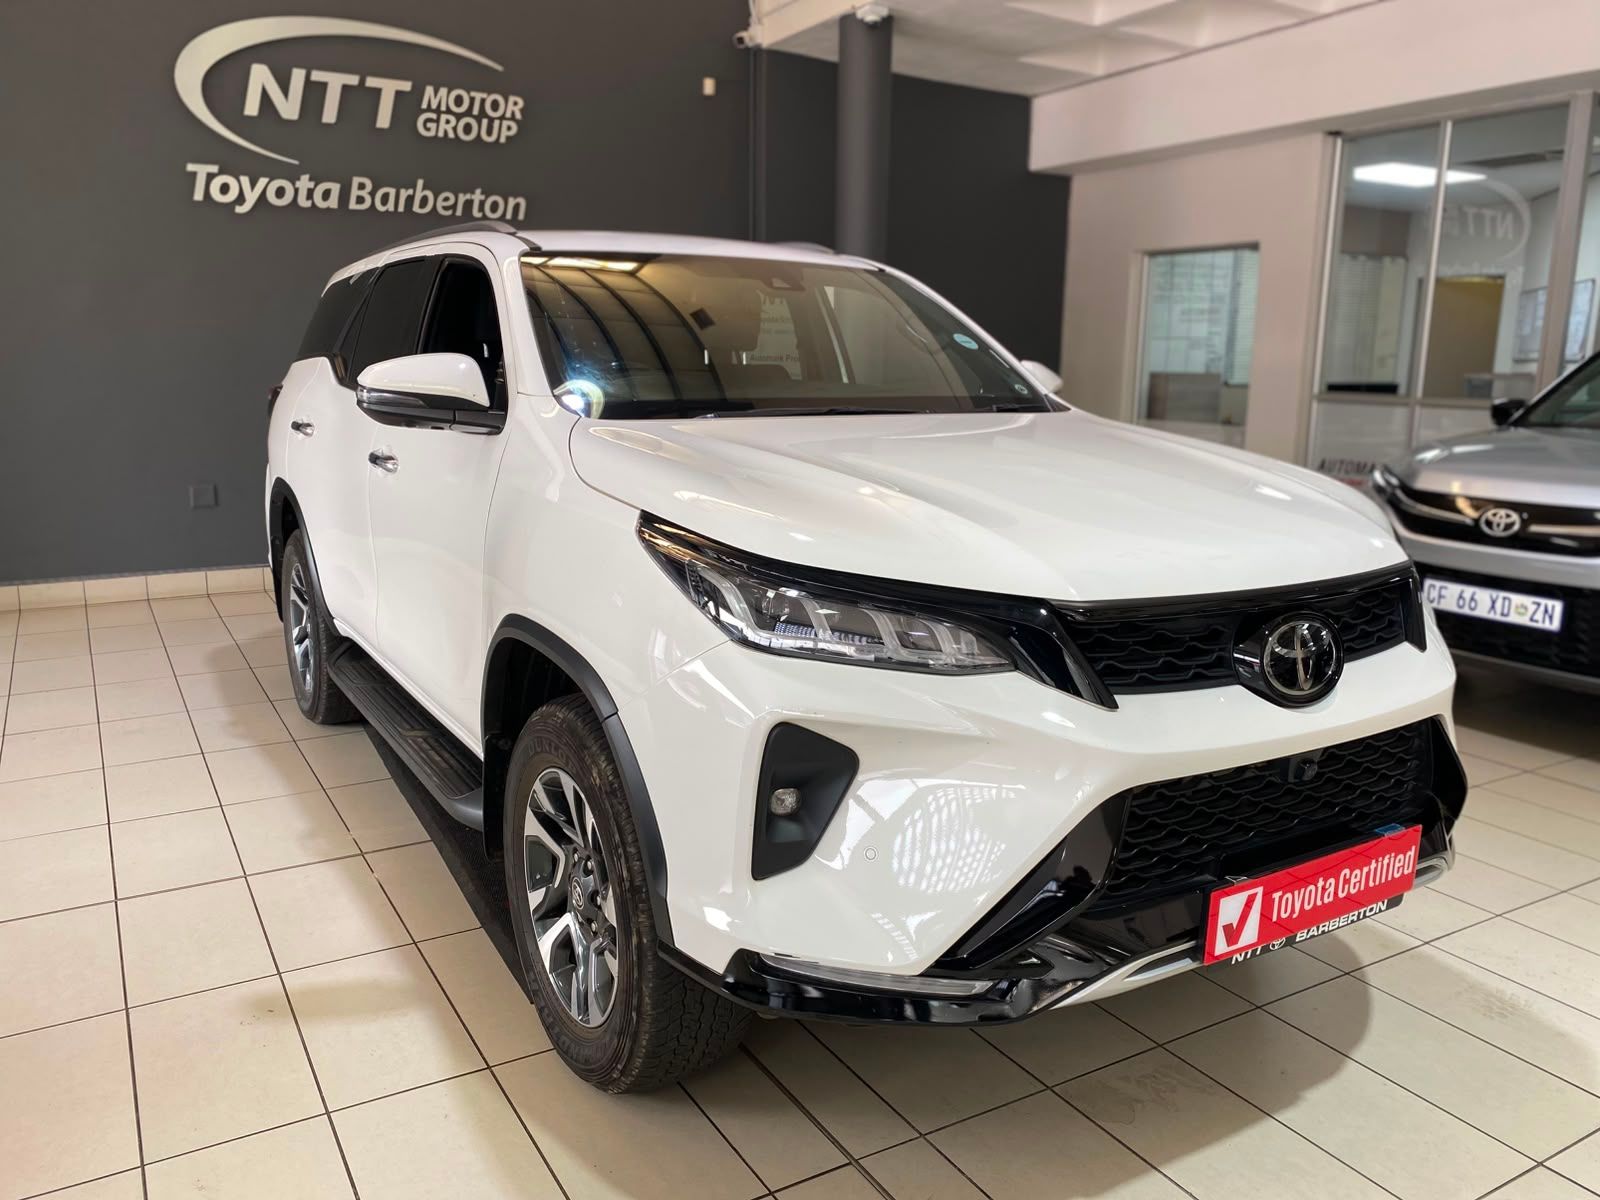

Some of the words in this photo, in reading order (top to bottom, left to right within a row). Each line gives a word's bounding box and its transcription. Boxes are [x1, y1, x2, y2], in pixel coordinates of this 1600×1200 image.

[243, 63, 412, 129] NTT
[421, 86, 524, 120] MOTOR
[416, 114, 518, 143] GROUP
[186, 162, 341, 214] Toyota
[348, 176, 527, 221] Barberton
[1426, 583, 1450, 606] CF
[1456, 590, 1479, 612] 66
[1487, 594, 1512, 618] XD
[1528, 600, 1556, 627] ZN
[1271, 877, 1336, 922] Toyota
[1338, 845, 1416, 899] Certified
[1295, 899, 1388, 942] BARBERTON
